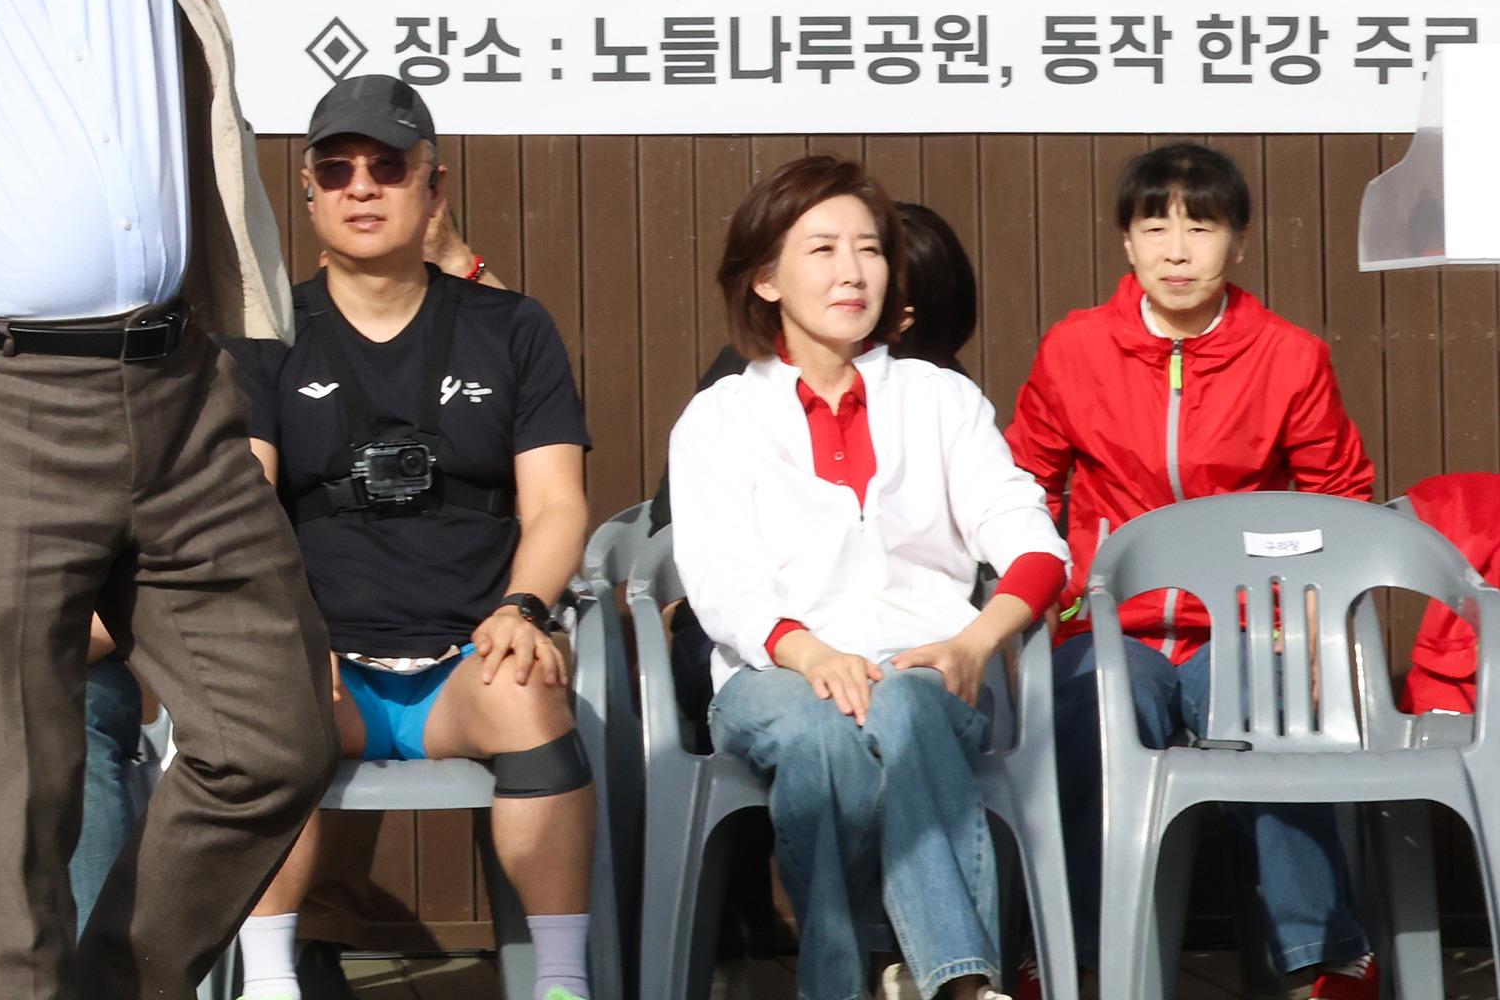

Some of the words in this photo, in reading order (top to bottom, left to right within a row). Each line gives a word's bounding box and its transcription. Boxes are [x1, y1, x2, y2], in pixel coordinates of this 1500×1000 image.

[394, 16, 522, 86] 장소
[592, 14, 1012, 88] 노들나루공원,
[1041, 15, 1173, 85] 동작
[1196, 13, 1329, 85] 한강
